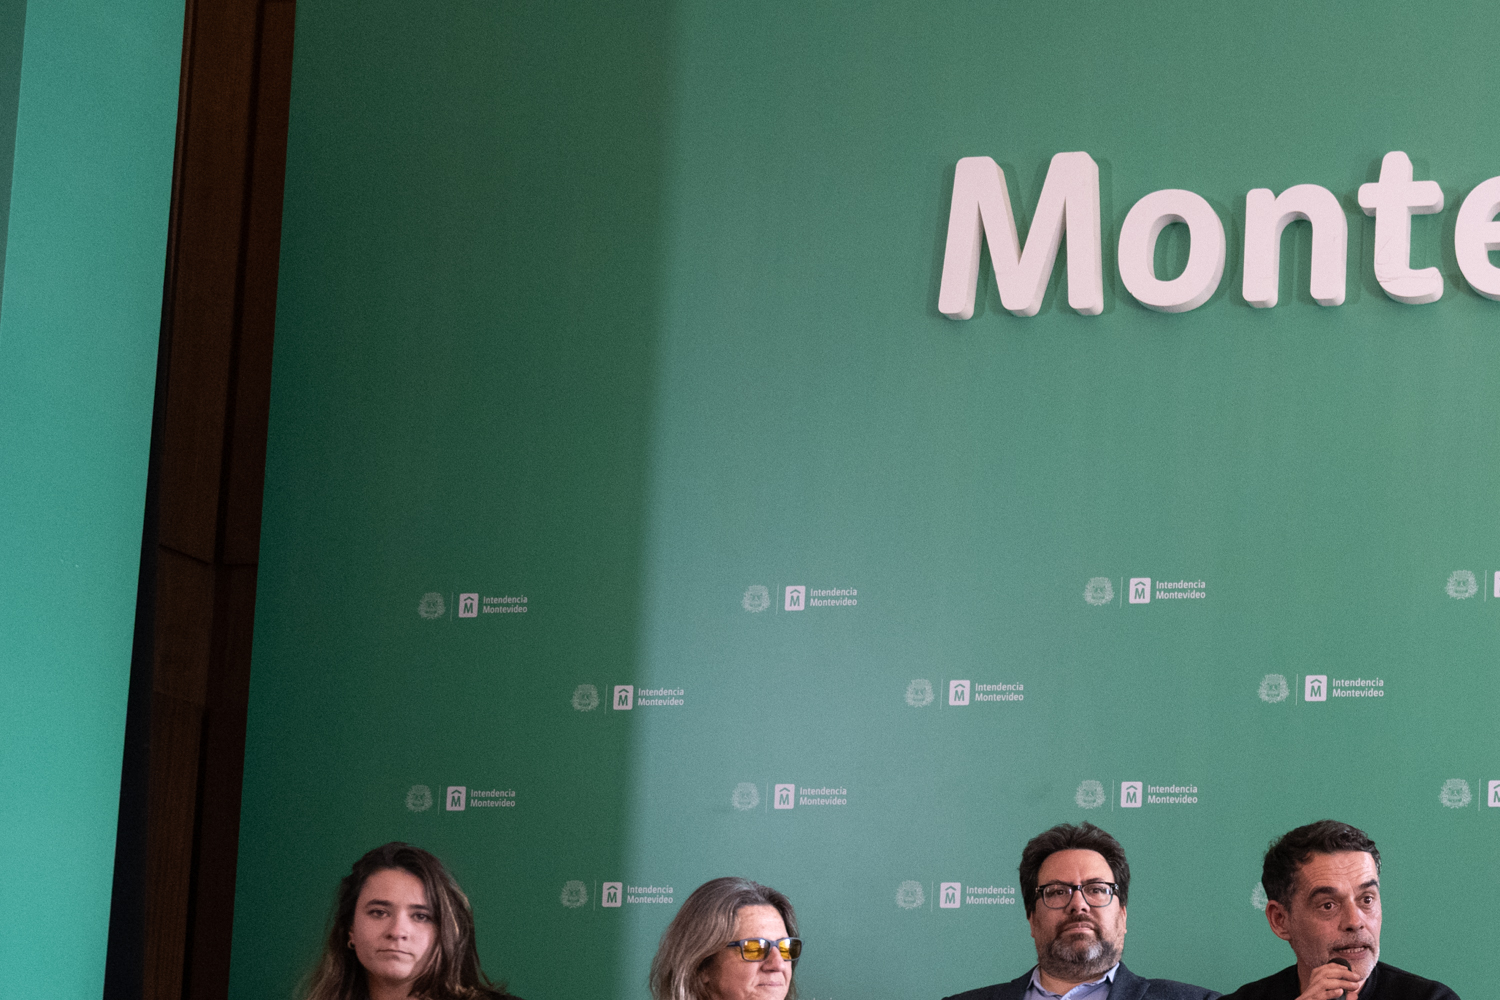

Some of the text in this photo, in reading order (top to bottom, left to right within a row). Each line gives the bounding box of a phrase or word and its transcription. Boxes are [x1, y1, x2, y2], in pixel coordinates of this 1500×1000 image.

[1155, 579, 1206, 590] Intendencia
[810, 587, 858, 597] Intendencia
[1155, 589, 1206, 600] Montevideo
[482, 595, 528, 604] Intendencia
[809, 597, 858, 607] Montevideo
[482, 604, 528, 614] Montevideo
[975, 682, 1024, 692] Intendencia
[1332, 677, 1385, 687] Intendencia
[637, 687, 685, 697] Intendencia
[974, 692, 1025, 702] Montevideo
[1332, 687, 1385, 698] Montevideo
[637, 697, 685, 706] Montevideo
[470, 788, 516, 798] Intendencia
[799, 786, 848, 796] Intendencia
[1147, 784, 1198, 794] Intendencia
[470, 798, 516, 808] Montevideo
[799, 796, 848, 806] Montevideo
[1147, 794, 1199, 804] Montevideo
[627, 885, 674, 894] Intendencia
[965, 885, 1015, 895] Intendencia
[626, 894, 674, 904] Montevideo
[965, 894, 1015, 905] Montevideo
